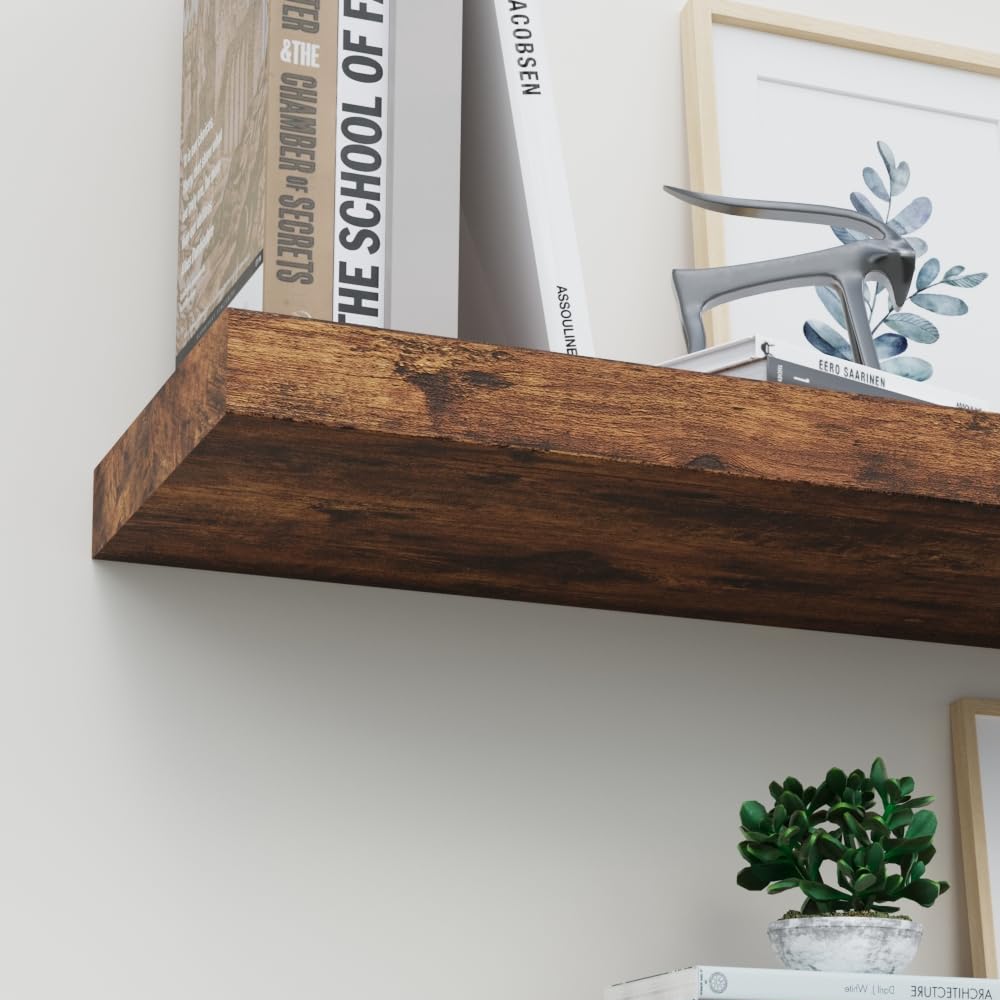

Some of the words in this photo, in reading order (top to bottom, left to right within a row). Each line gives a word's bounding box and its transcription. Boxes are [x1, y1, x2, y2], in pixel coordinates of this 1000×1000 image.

[342, 0, 384, 23] F
[508, 0, 541, 95] ACOBSEN
[341, 29, 384, 83] OF
[277, 72, 318, 175] CHAMBER
[338, 96, 384, 256] SCHOOL
[275, 196, 316, 286] SECRETS
[556, 285, 578, 356] ASSOULINE
[818, 359, 841, 376] EERO
[843, 367, 886, 388] SAARINEN
